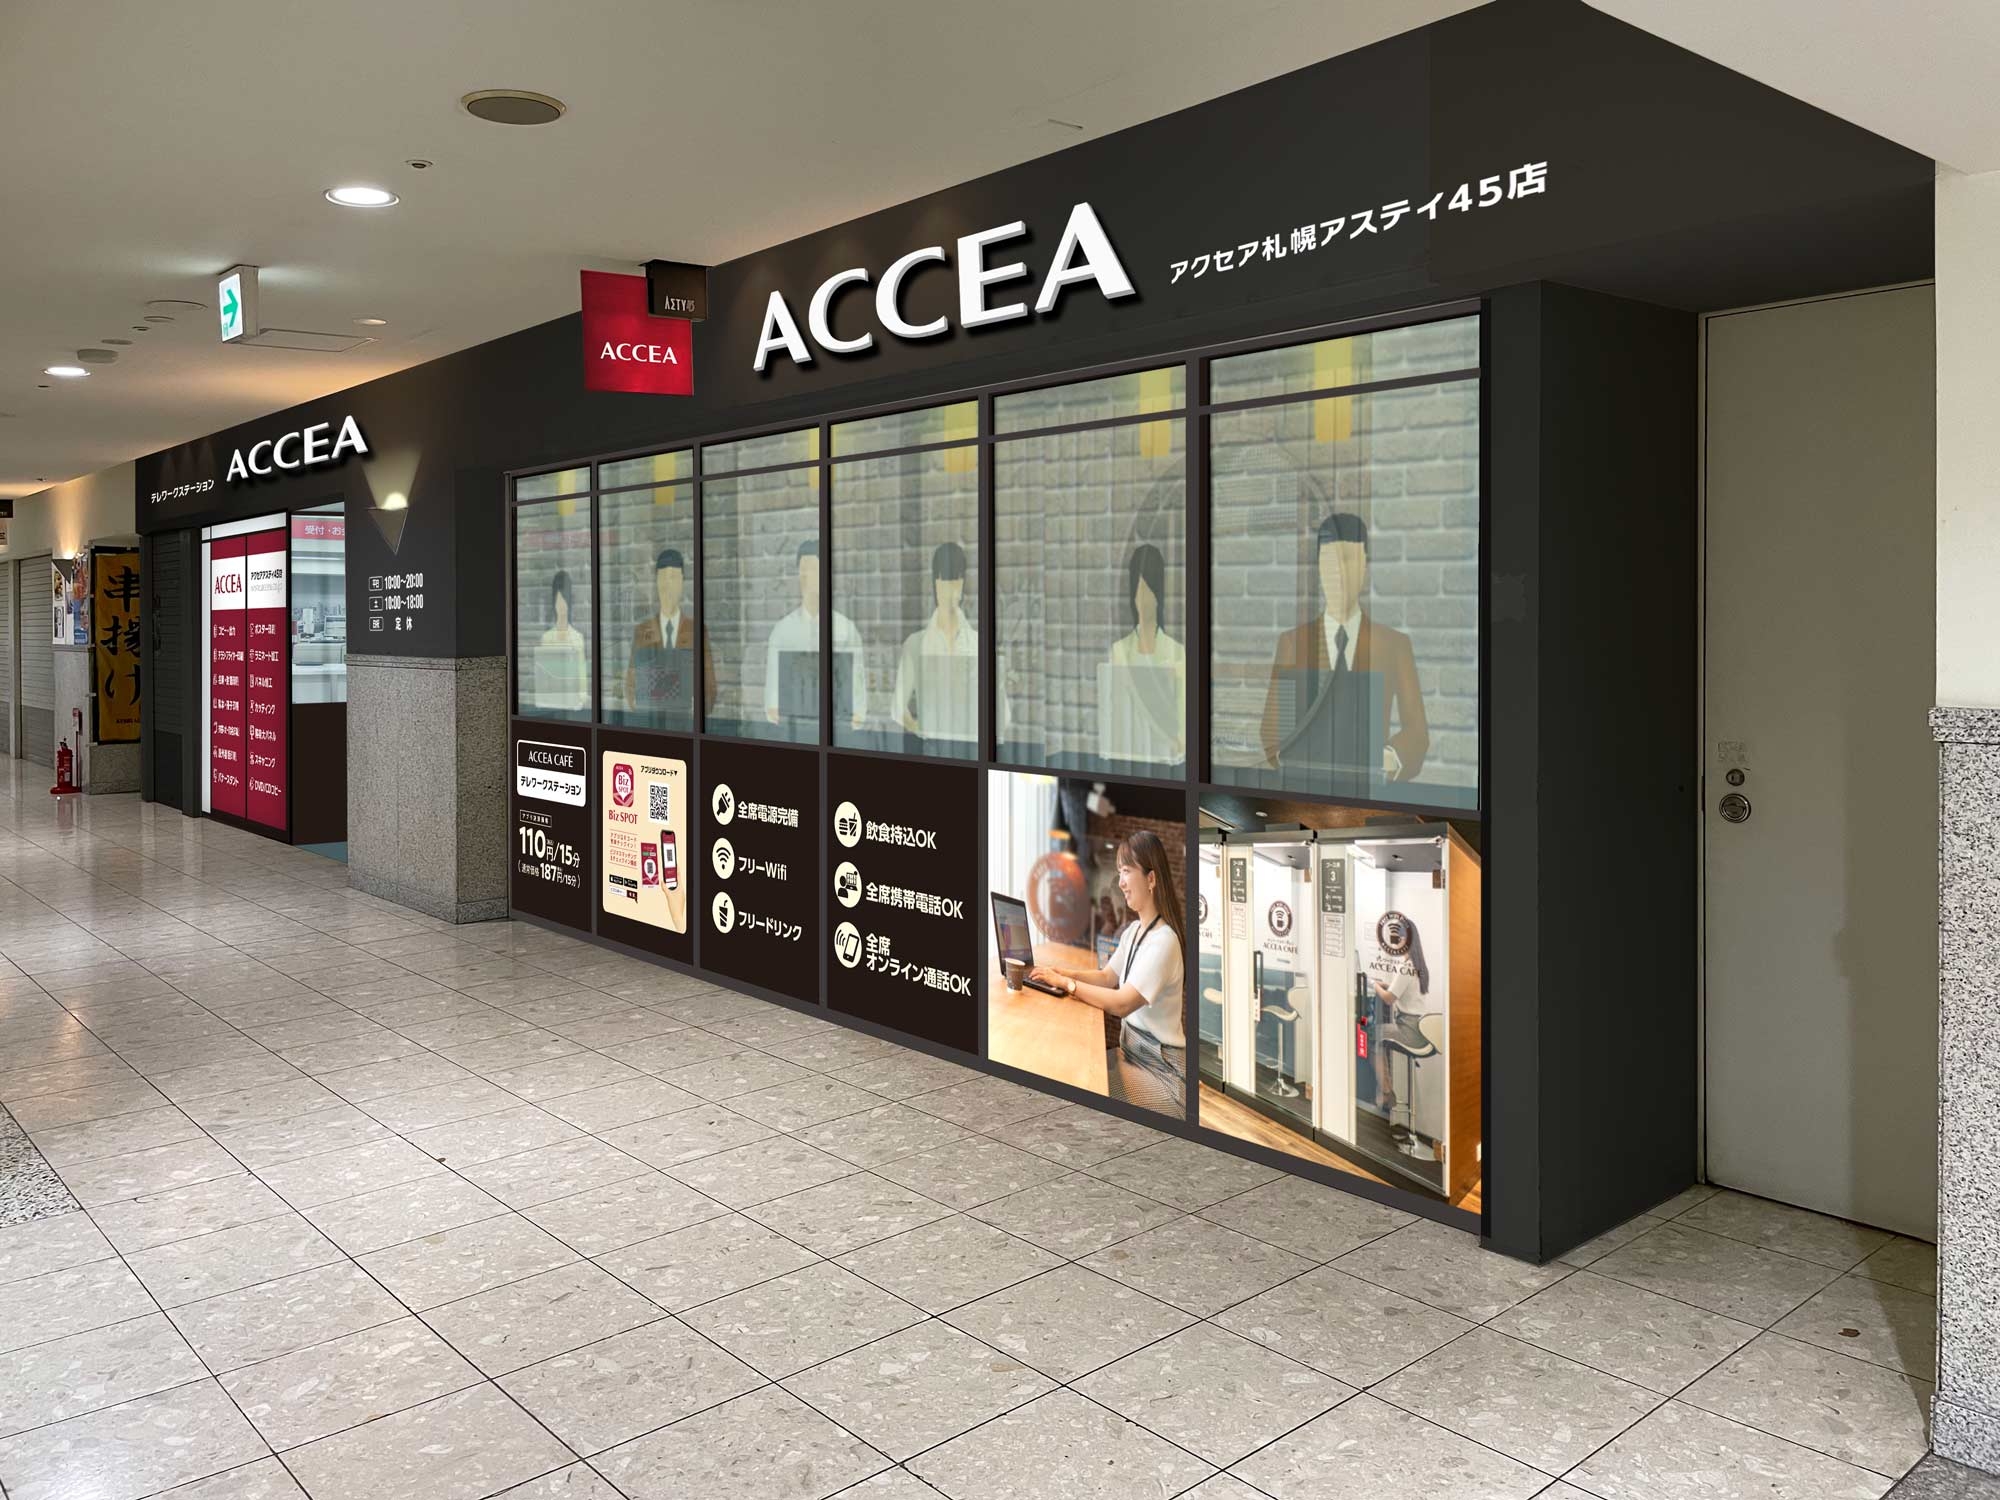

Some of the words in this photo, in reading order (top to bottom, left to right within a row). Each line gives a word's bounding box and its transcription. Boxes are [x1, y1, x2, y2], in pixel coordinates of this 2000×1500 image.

[1170, 161, 1548, 284] アクセア札幌アスティ45店
[753, 201, 1136, 372] ACCEA
[600, 342, 677, 365] ACCEA
[226, 414, 368, 483] ACCEA
[150, 479, 215, 504] テレワークステーション
[304, 524, 345, 536] 受付・お
[214, 574, 242, 594] ACCEA
[528, 750, 553, 766] ACCEA
[554, 752, 574, 768] CAFÉ
[520, 775, 582, 796] テレワークステーション
[618, 774, 629, 786] Biz
[608, 810, 619, 821] Biz
[620, 812, 638, 825] SPOT
[738, 801, 799, 828] 全席電源完備
[866, 820, 937, 850] 飲食持込OK
[738, 856, 787, 881] フリーWifi
[866, 883, 964, 919] 全席携帯電話OK
[738, 911, 803, 942] フリードリンク
[866, 933, 891, 956] 全席
[866, 954, 972, 997] オンライン通話OK
[1369, 962, 1398, 974] ACCEA
